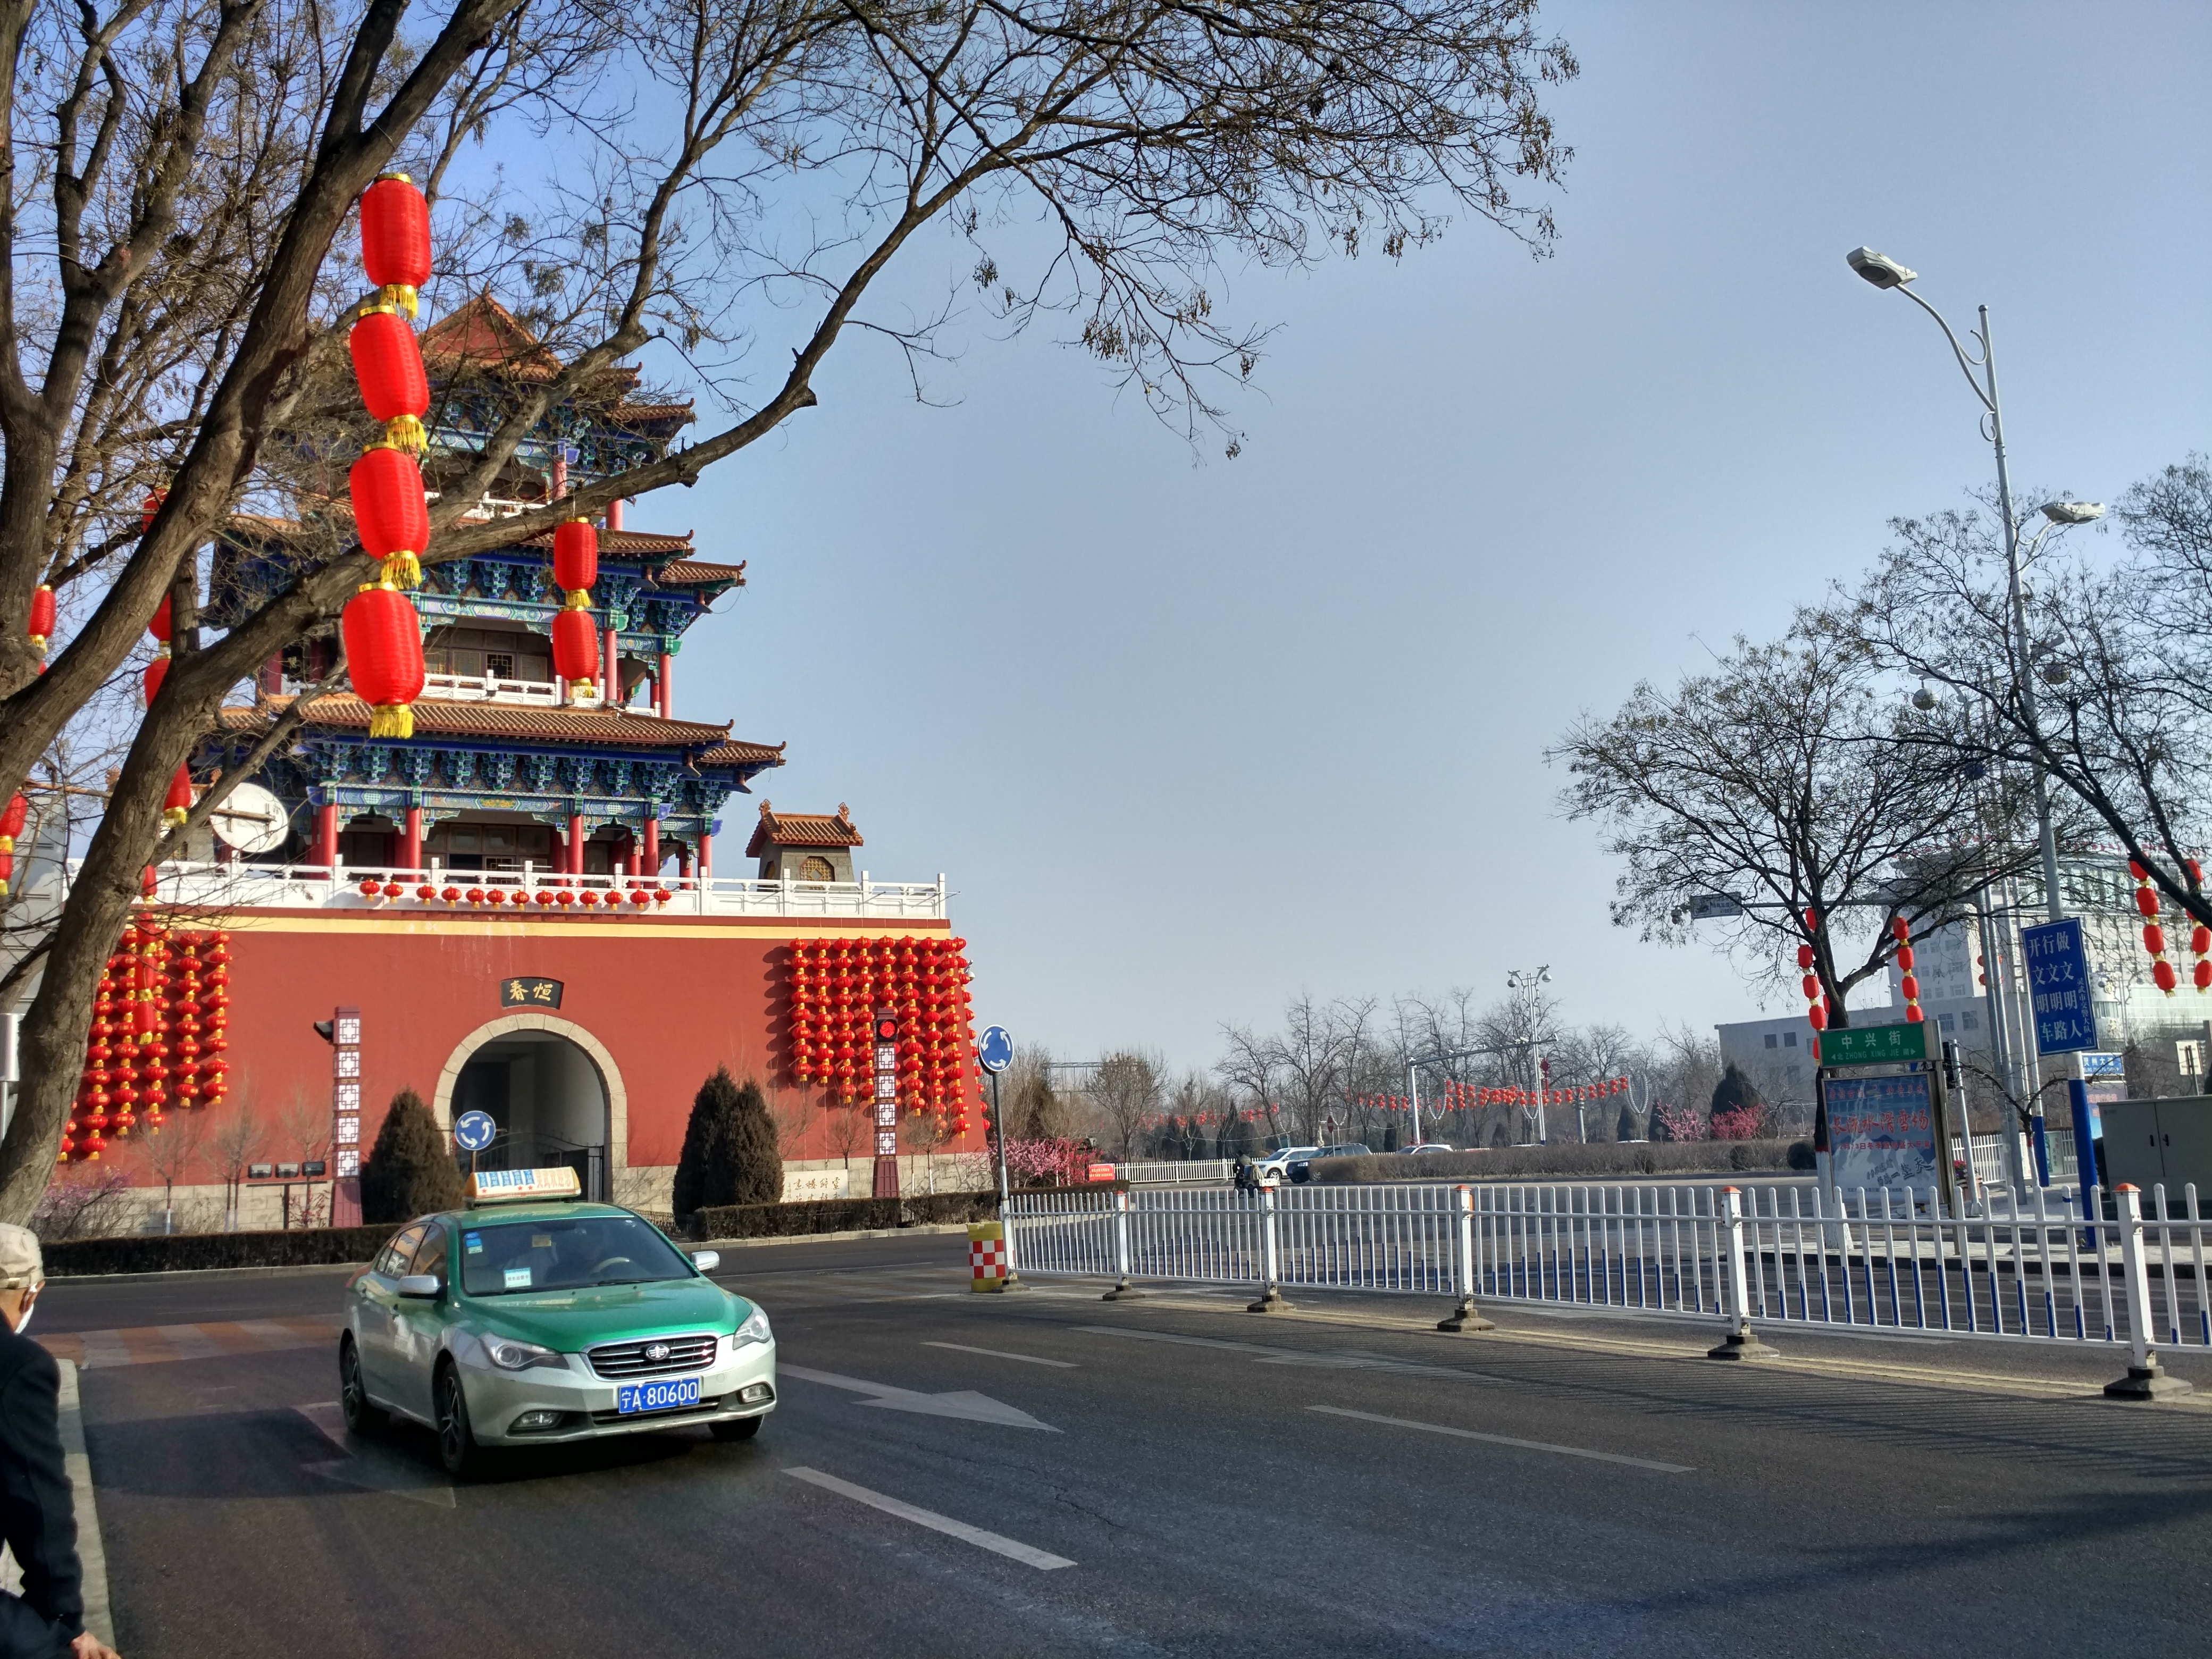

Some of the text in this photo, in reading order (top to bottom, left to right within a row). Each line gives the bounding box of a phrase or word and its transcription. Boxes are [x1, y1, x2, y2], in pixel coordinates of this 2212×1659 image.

[1841, 1030, 1900, 1049] 中兴街
[1846, 1051, 1867, 1060] ZHONG
[1871, 1049, 1886, 1058] XING
[1831, 1109, 1930, 1136] 长流水滑雪场
